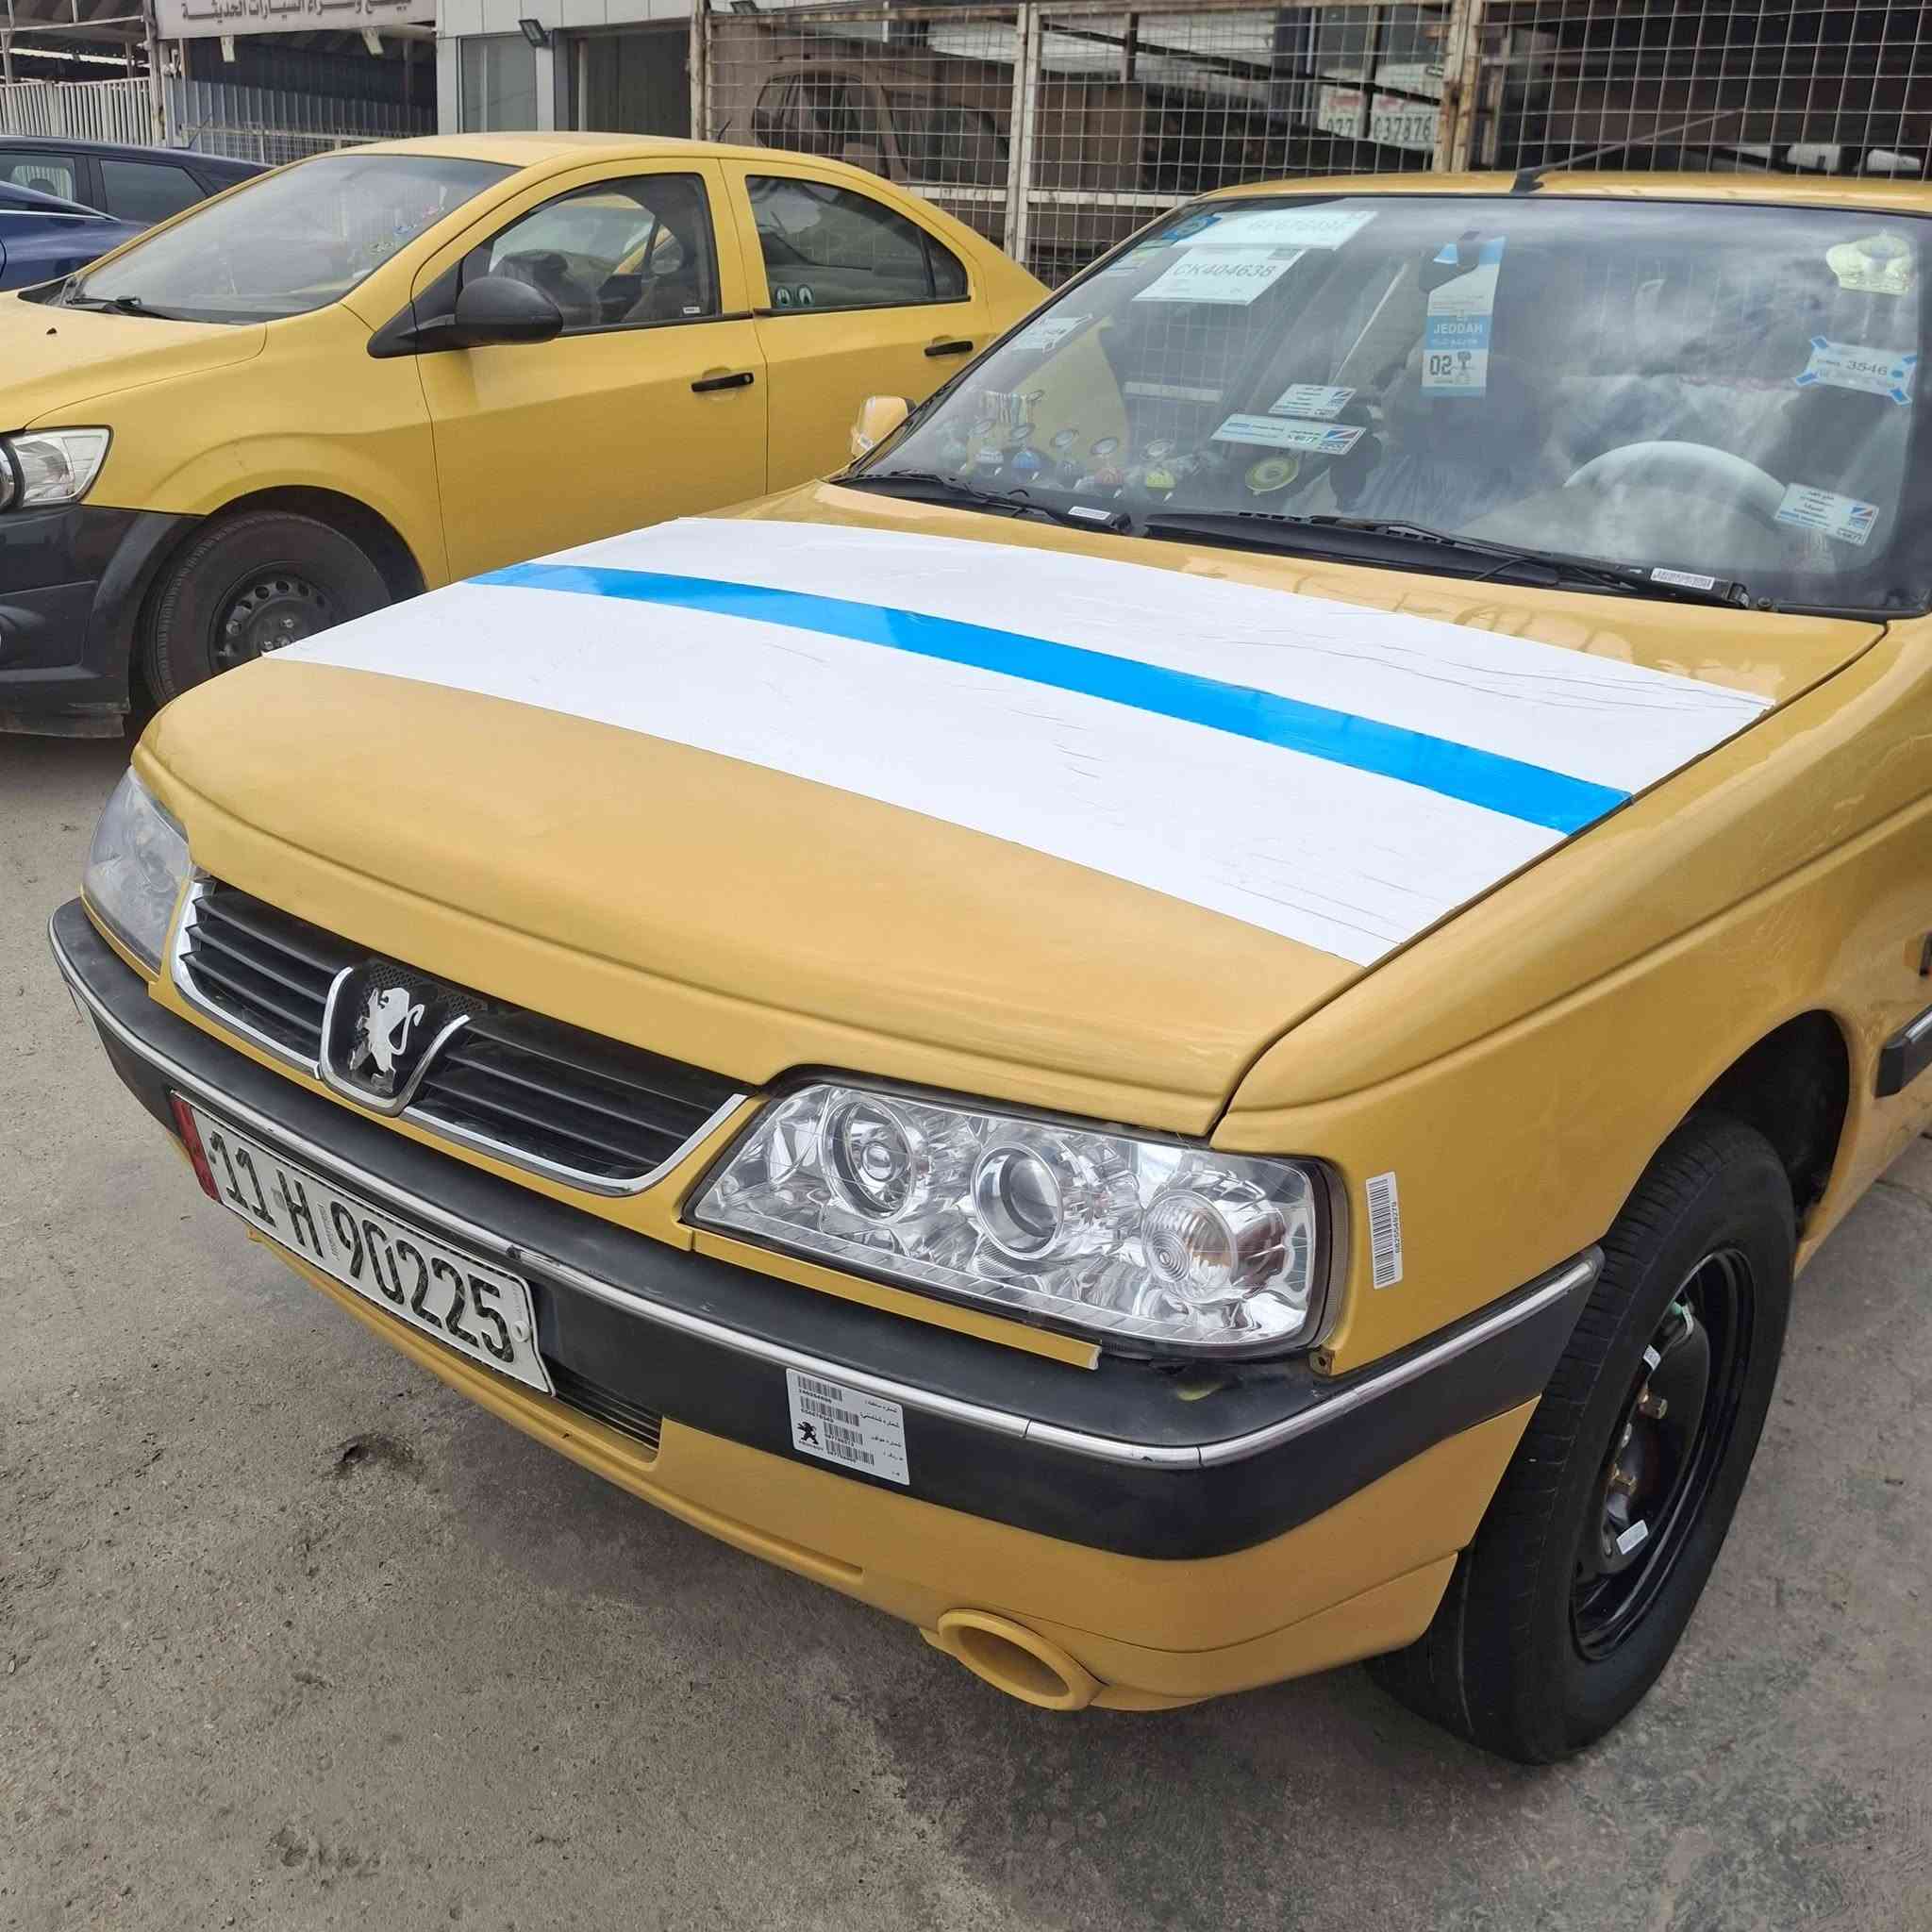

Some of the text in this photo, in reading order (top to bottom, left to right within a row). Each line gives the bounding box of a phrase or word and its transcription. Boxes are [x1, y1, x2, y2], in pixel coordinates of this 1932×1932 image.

[1433, 324, 1484, 334] JEDDAH
[209, 1130, 277, 1227] 11
[276, 1168, 325, 1258] H
[329, 1201, 515, 1364] 90225
